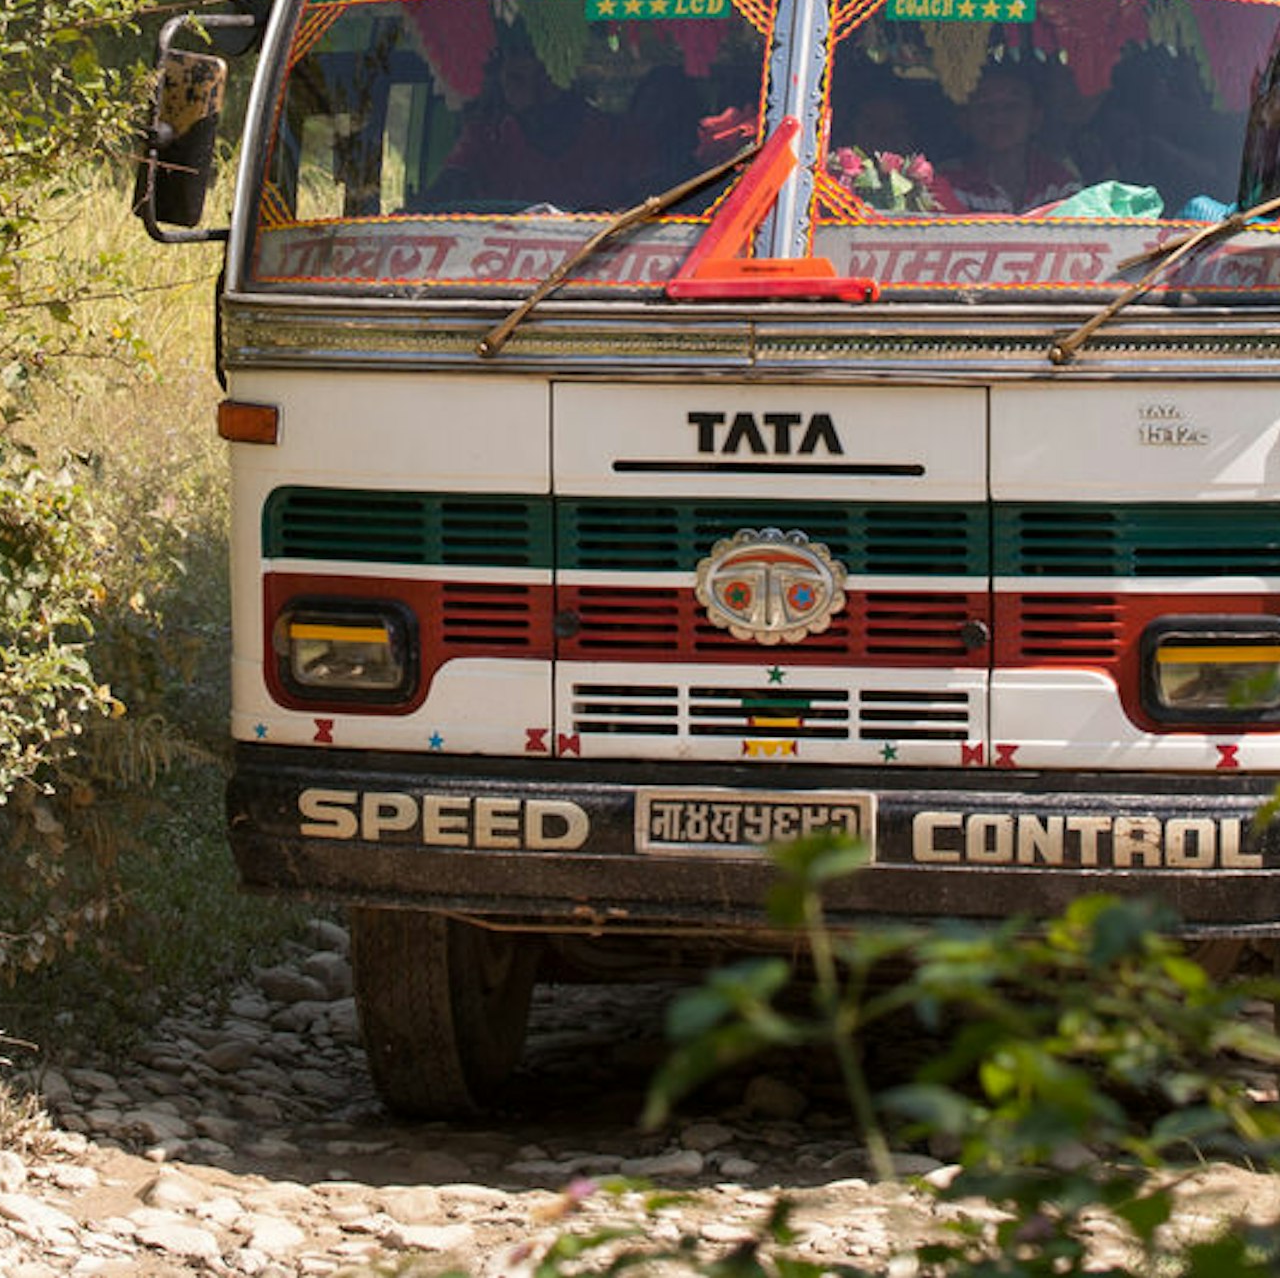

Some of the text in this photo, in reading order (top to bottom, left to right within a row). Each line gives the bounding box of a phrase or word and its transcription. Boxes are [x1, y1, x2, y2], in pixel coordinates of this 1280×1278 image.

[687, 412, 844, 455] TATA
[297, 787, 590, 851] SPEED
[912, 810, 1264, 869] CONTROL
